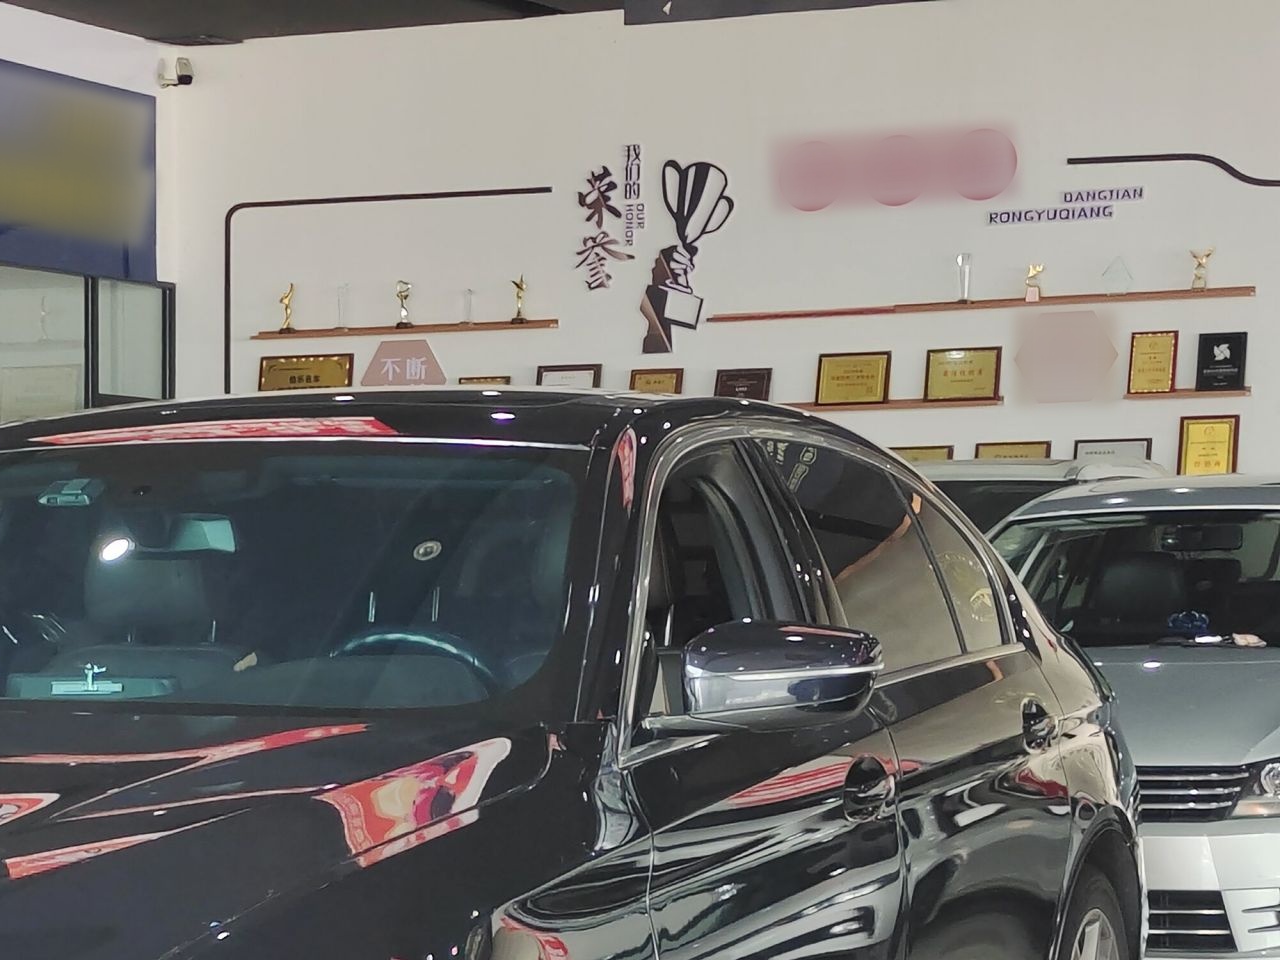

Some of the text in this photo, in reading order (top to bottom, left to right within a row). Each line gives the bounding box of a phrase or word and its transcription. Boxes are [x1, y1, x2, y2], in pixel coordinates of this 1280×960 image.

[624, 144, 641, 200] 我们的
[1063, 187, 1144, 203] DANGJIAN
[575, 165, 636, 291] 荣誉
[625, 204, 634, 247] HONOR
[636, 203, 645, 230] OUR
[988, 205, 1114, 225] RONGYUQIANG
[379, 357, 428, 381] 不断
